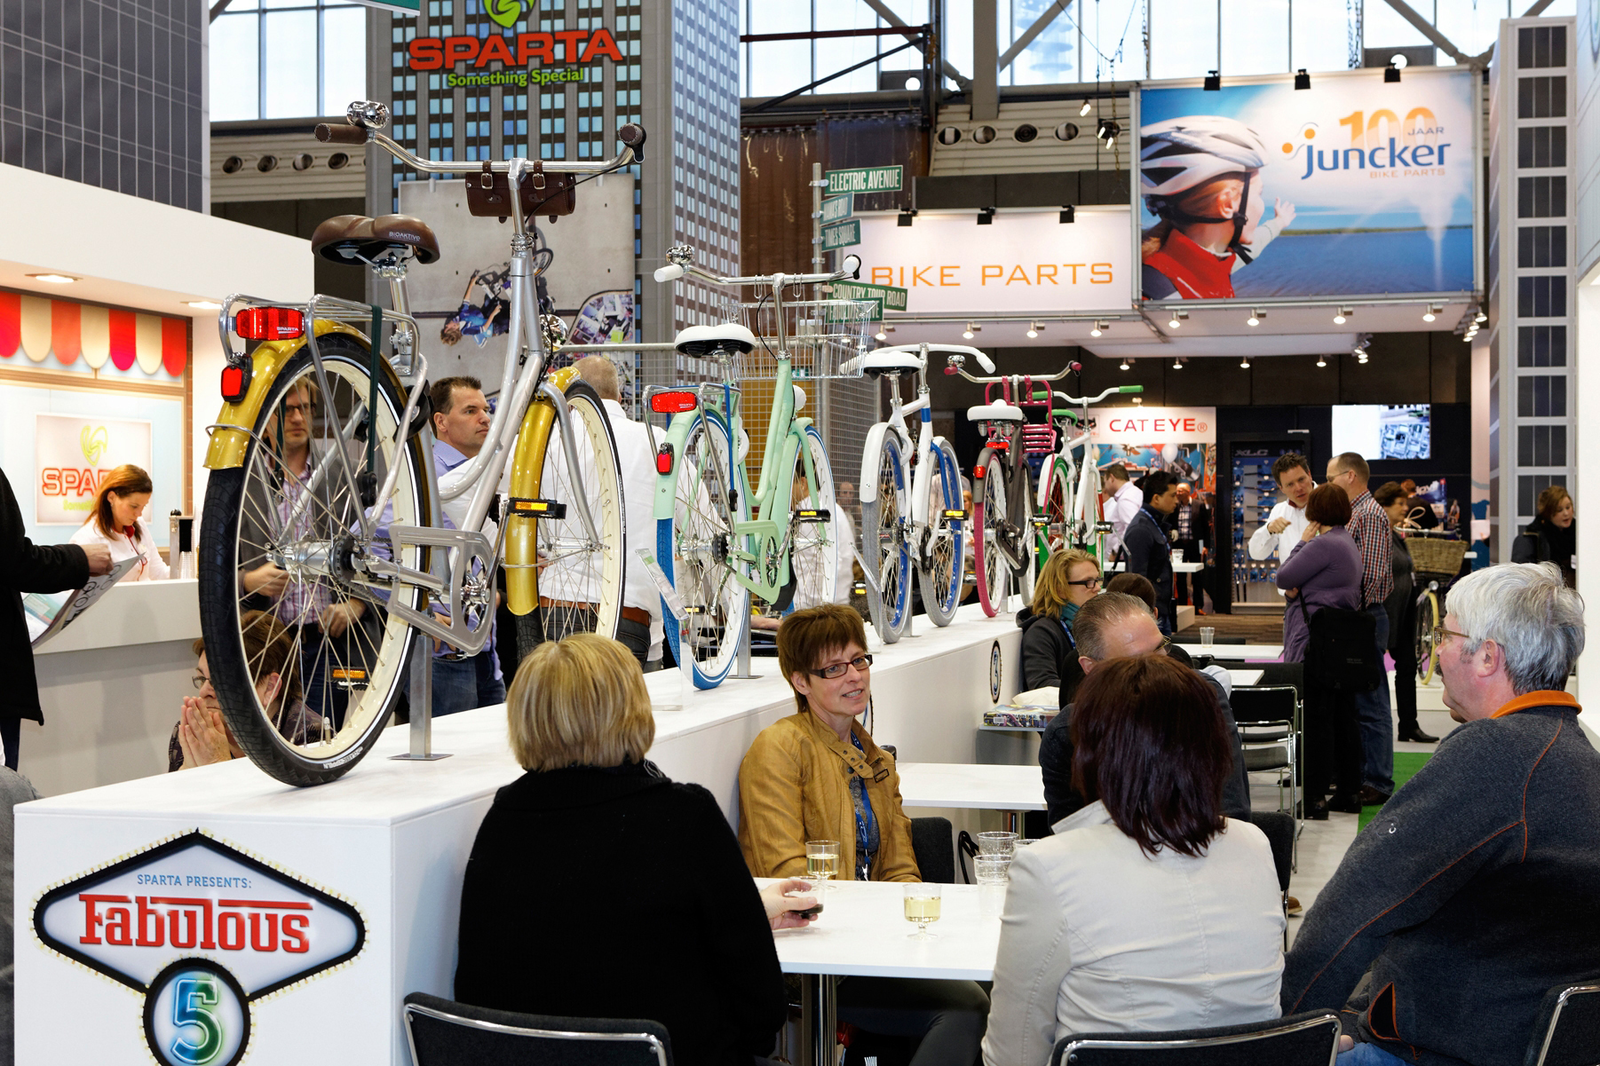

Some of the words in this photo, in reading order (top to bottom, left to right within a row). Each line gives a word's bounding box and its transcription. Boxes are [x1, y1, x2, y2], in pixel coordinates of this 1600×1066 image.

[408, 28, 624, 71] SPARTA
[448, 70, 527, 87] Something
[531, 67, 584, 85] Special
[1339, 106, 1438, 160] 100
[1408, 126, 1445, 136] JAAR
[1301, 128, 1451, 180] juncker
[830, 171, 866, 192] ELECTRIC
[867, 169, 900, 190] AVENUE
[1370, 170, 1399, 179] BIKE
[1404, 168, 1445, 177] PARTS
[871, 265, 961, 287] BIKE
[981, 262, 1113, 286] PARTS
[833, 284, 866, 299] COUNTRY
[886, 290, 906, 307] ROAD
[137, 874, 182, 886] SPARTA
[186, 875, 252, 889] PRESENTS:
[79, 894, 313, 953] Fabulous
[171, 978, 222, 1065] 5
